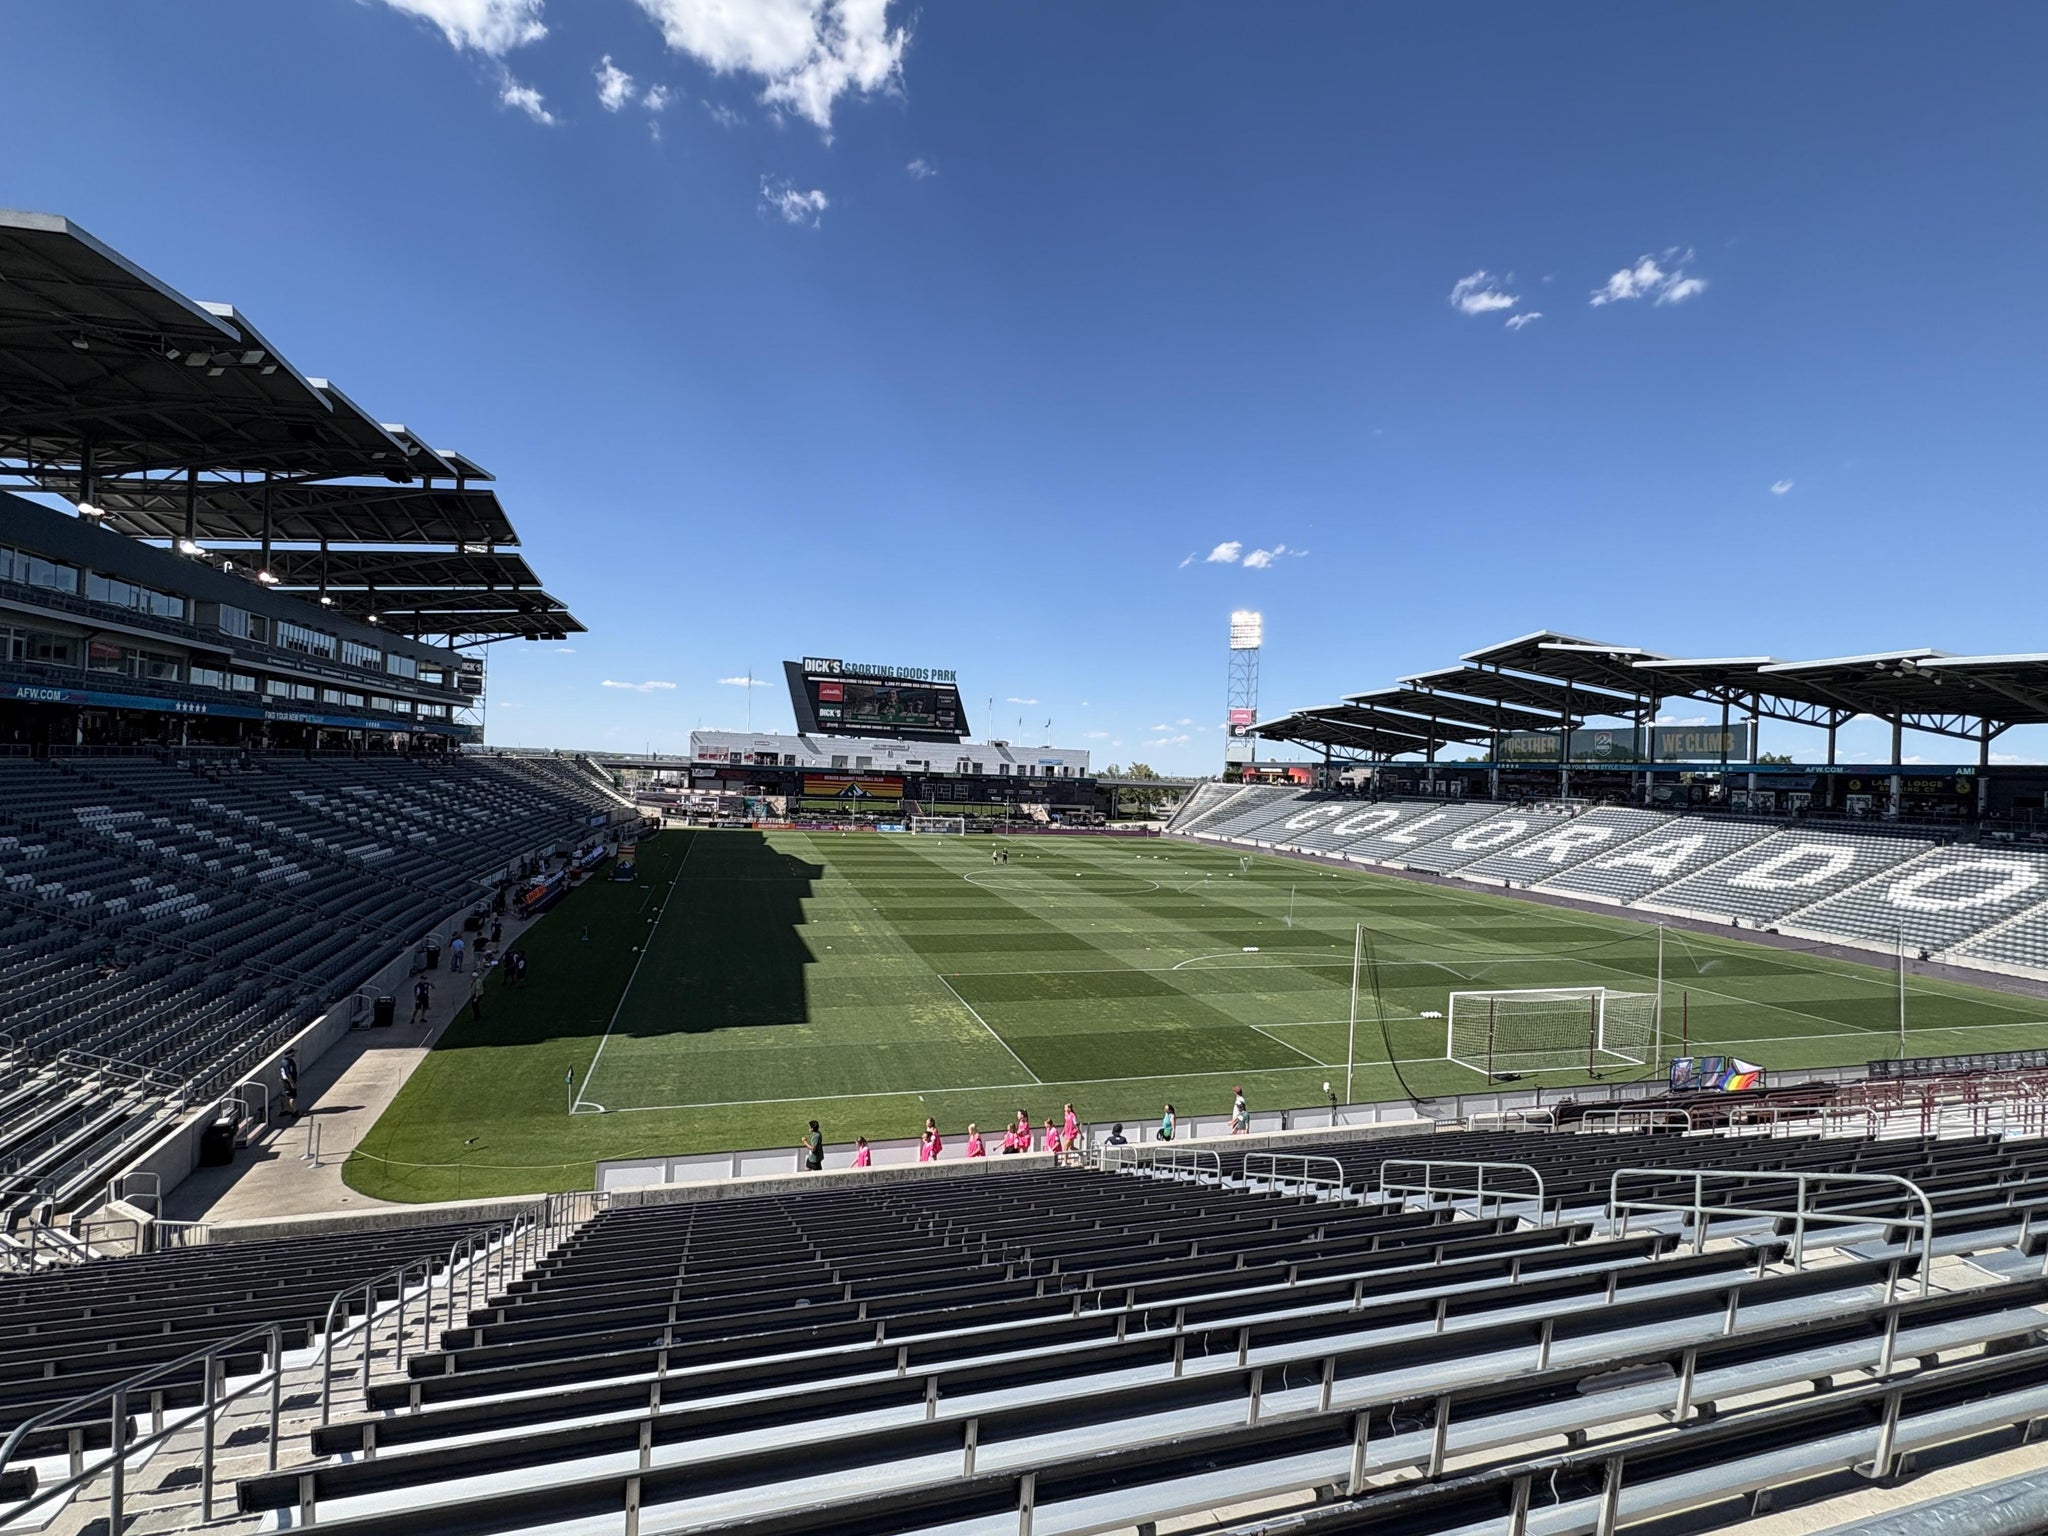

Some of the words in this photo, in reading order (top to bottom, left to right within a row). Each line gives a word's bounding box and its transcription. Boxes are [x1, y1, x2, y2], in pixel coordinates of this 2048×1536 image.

[804, 658, 841, 674] DICK'S
[844, 662, 894, 678] SPORTING
[897, 666, 929, 680] GOODS
[931, 669, 957, 682] PARK
[16, 687, 61, 701] AFW.COM
[1504, 736, 1556, 753] TOGETHER
[1661, 734, 1684, 752] WE
[1685, 732, 1735, 753] CLIMB
[1804, 766, 1844, 774] AFW.COM
[1285, 805, 2040, 912] COLORADO
